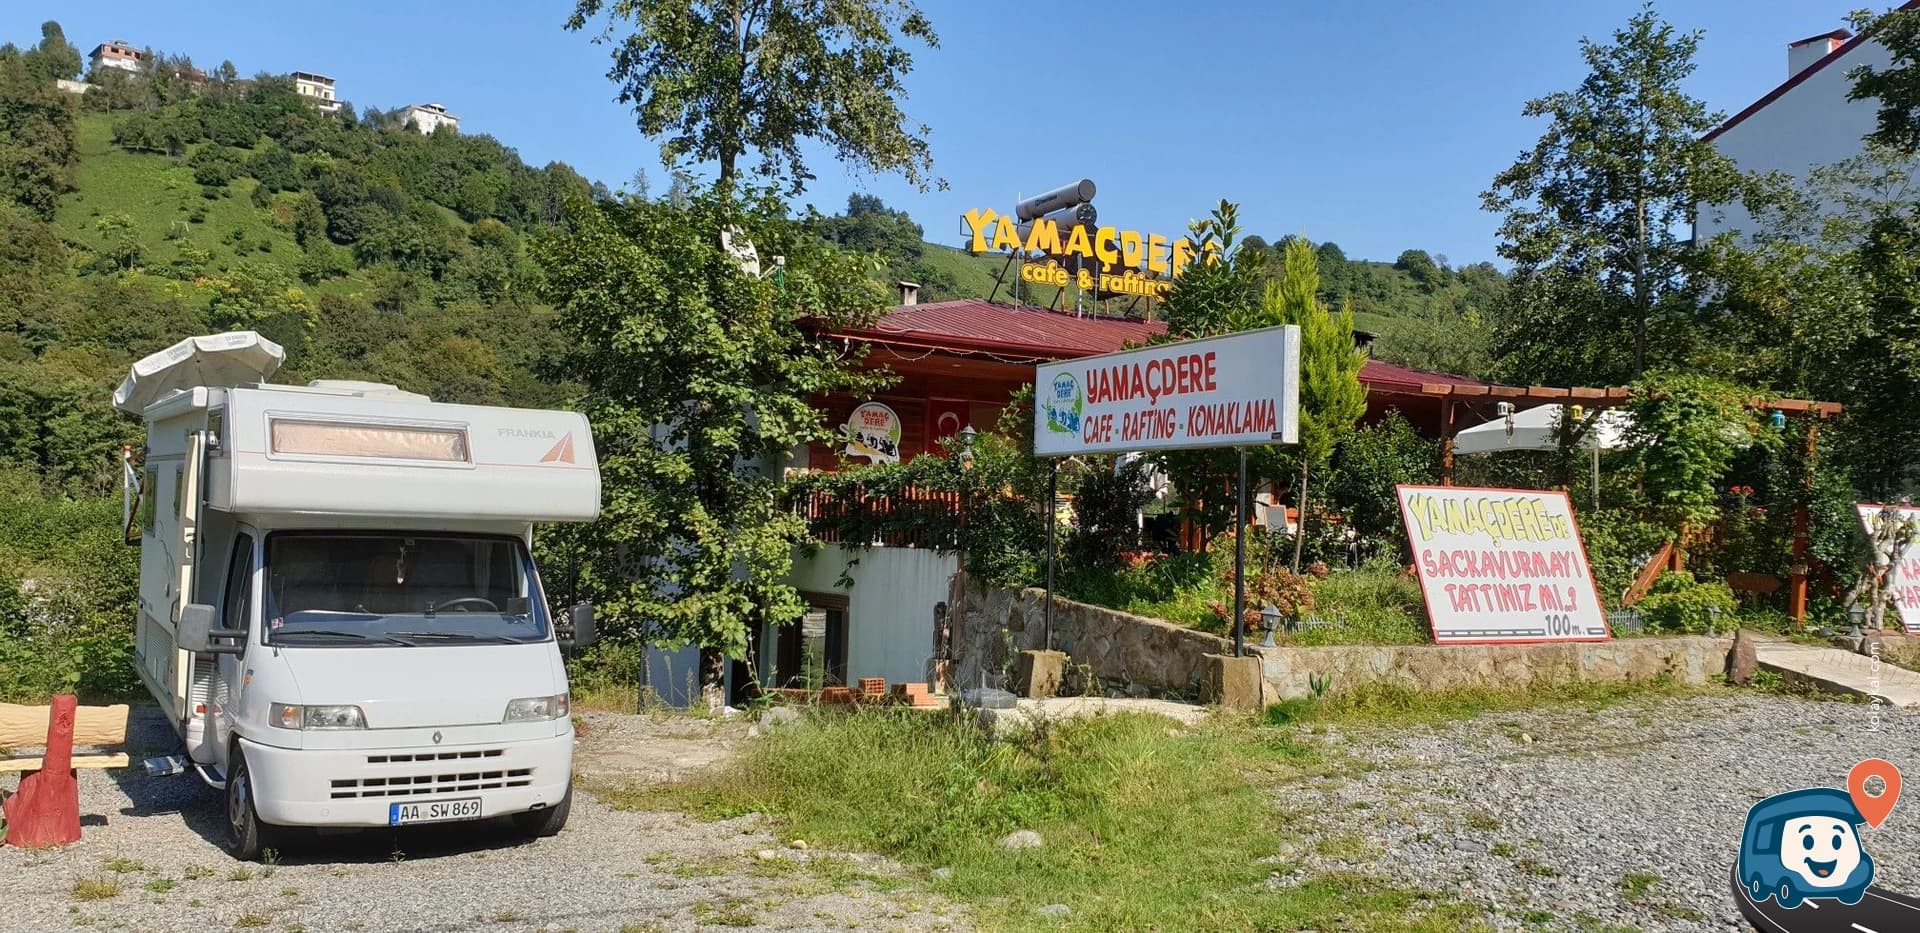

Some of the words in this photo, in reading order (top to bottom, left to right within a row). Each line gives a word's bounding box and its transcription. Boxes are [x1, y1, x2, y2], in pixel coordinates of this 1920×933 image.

[1021, 260, 1070, 287] cafe
[1077, 268, 1093, 290] &
[1086, 352, 1217, 405] YAMAÇDERE
[497, 428, 556, 439] FRANKIA
[1083, 413, 1113, 444] CAFE
[1186, 399, 1277, 437] KONAKLAMA
[1422, 549, 1583, 580] SACKAVURMAYI
[1444, 583, 1537, 613] TATTINIZ
[401, 806, 420, 820] AA
[430, 803, 450, 818] SW
[452, 801, 479, 816] 869
